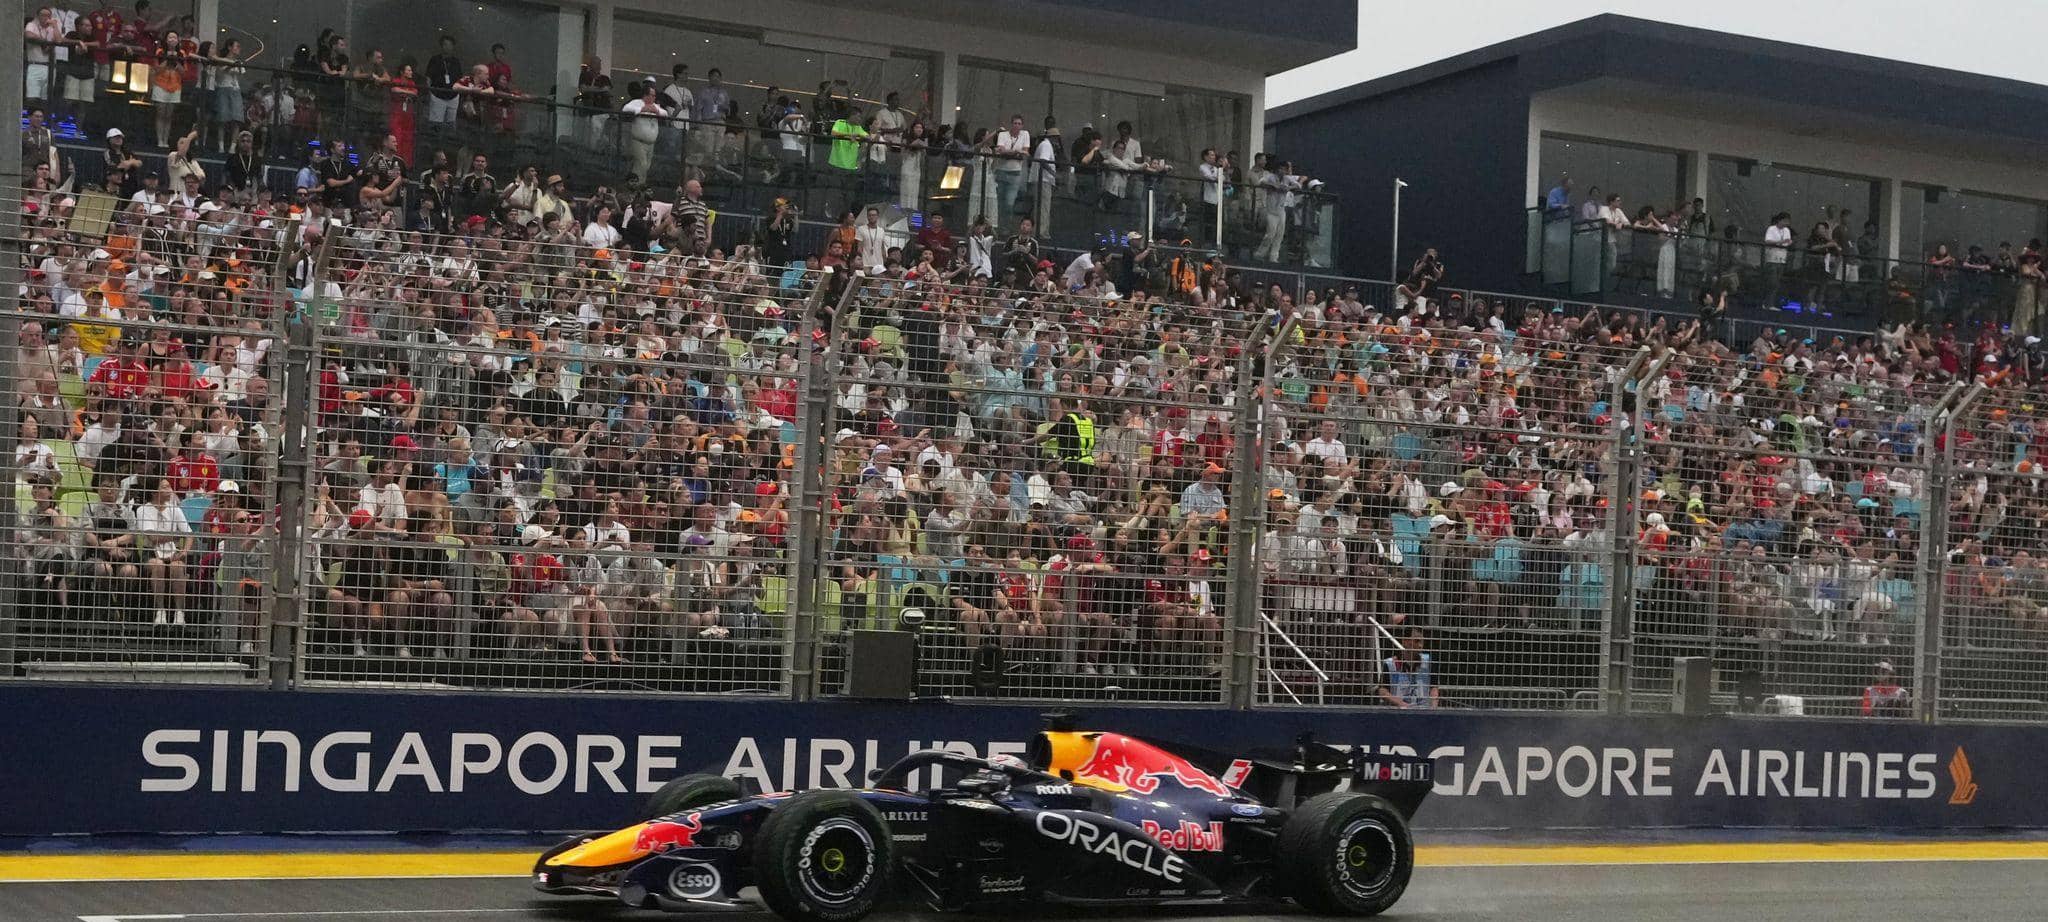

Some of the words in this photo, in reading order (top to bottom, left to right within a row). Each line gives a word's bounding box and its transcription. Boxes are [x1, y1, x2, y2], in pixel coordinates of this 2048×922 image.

[722, 737, 1026, 793] AIRLIN
[1328, 745, 1674, 797] GAPORE
[1364, 763, 1411, 780] Mobil
[1036, 783, 1073, 795] ROKT
[880, 811, 929, 821] ARLYLE
[1036, 812, 1184, 883] ORACLE
[1188, 822, 1224, 851] Bull
[677, 872, 713, 888] Esso
